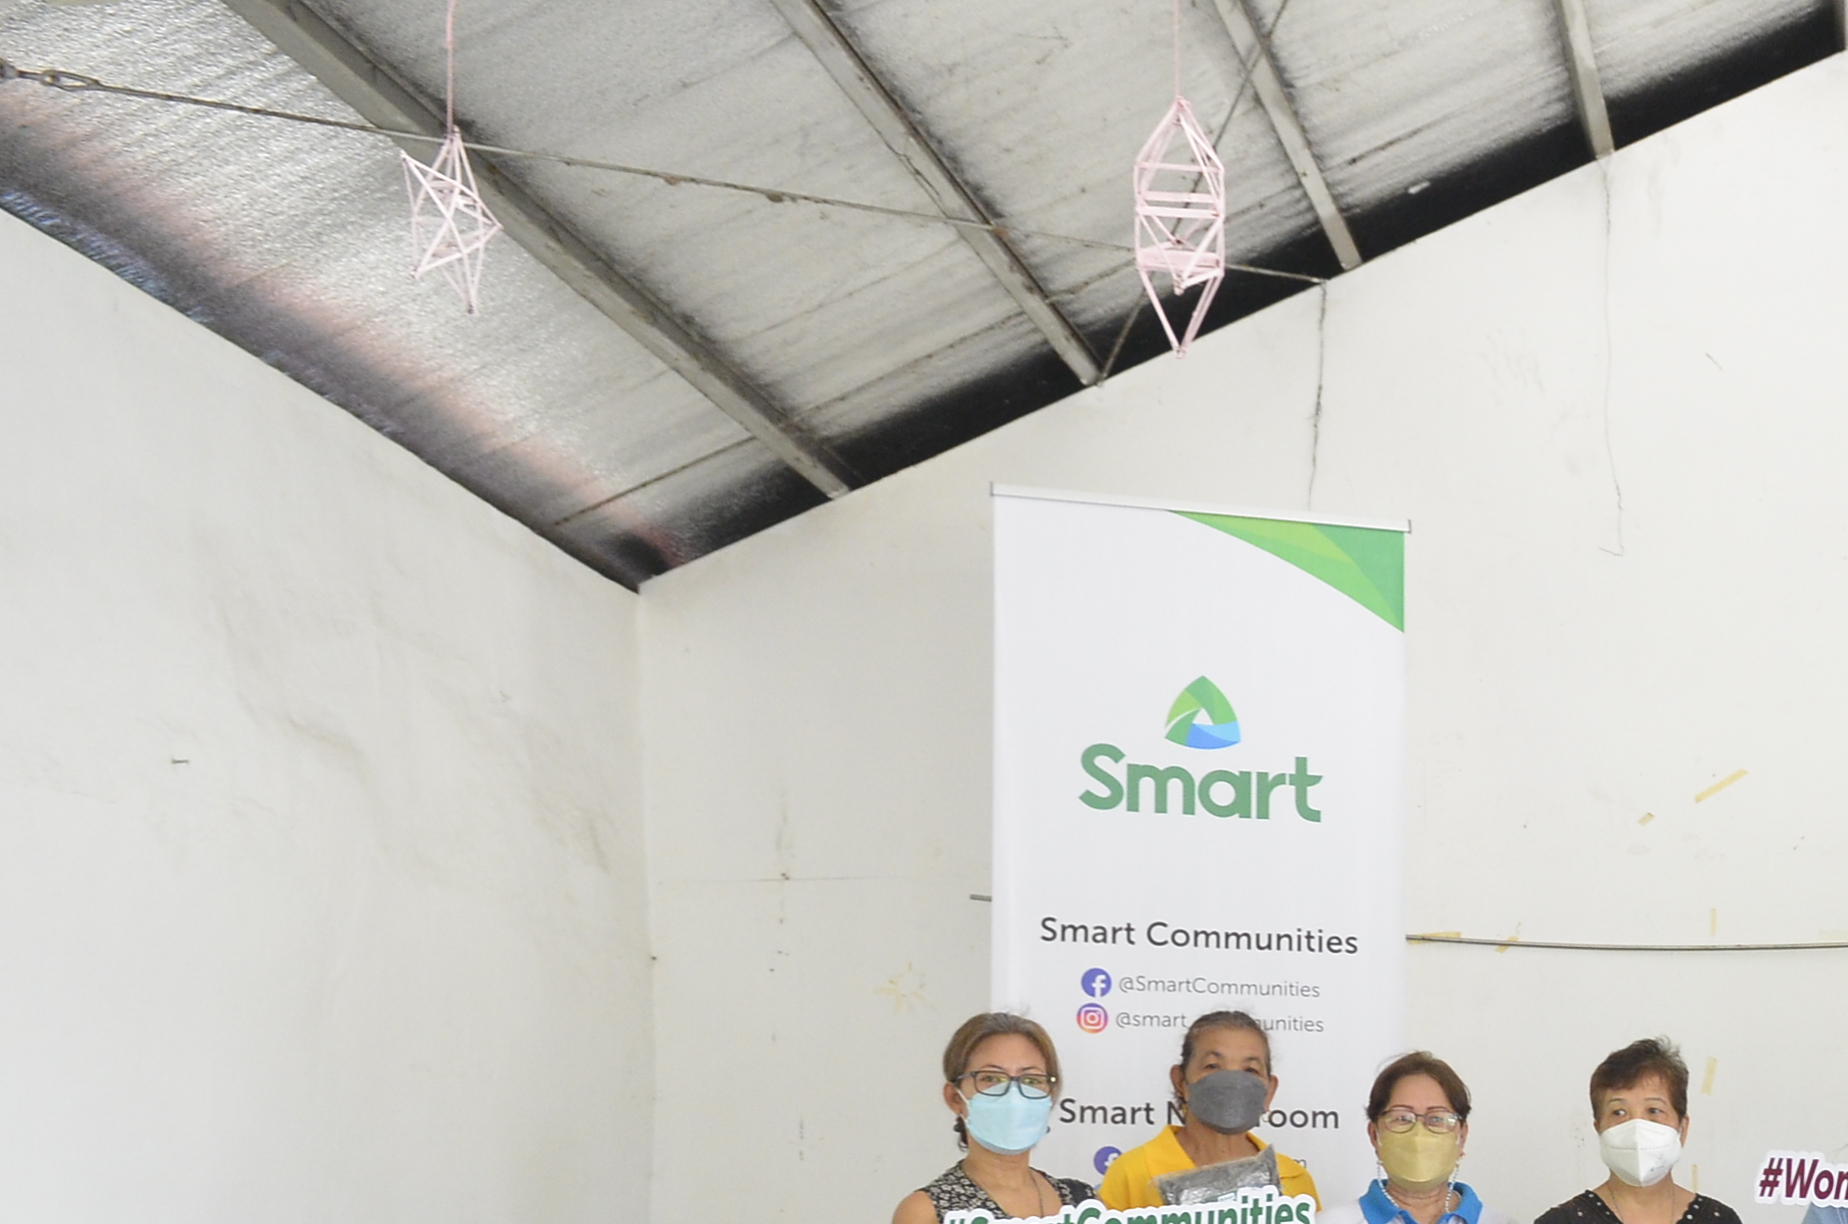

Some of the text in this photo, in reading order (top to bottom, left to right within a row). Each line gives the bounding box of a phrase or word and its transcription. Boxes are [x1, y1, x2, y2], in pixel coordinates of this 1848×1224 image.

[1078, 743, 1324, 823] Smart
[1040, 916, 1359, 955] Smart Communities
[1119, 975, 1321, 998] @SmartCommunities
[1059, 1098, 1155, 1126] Smart
